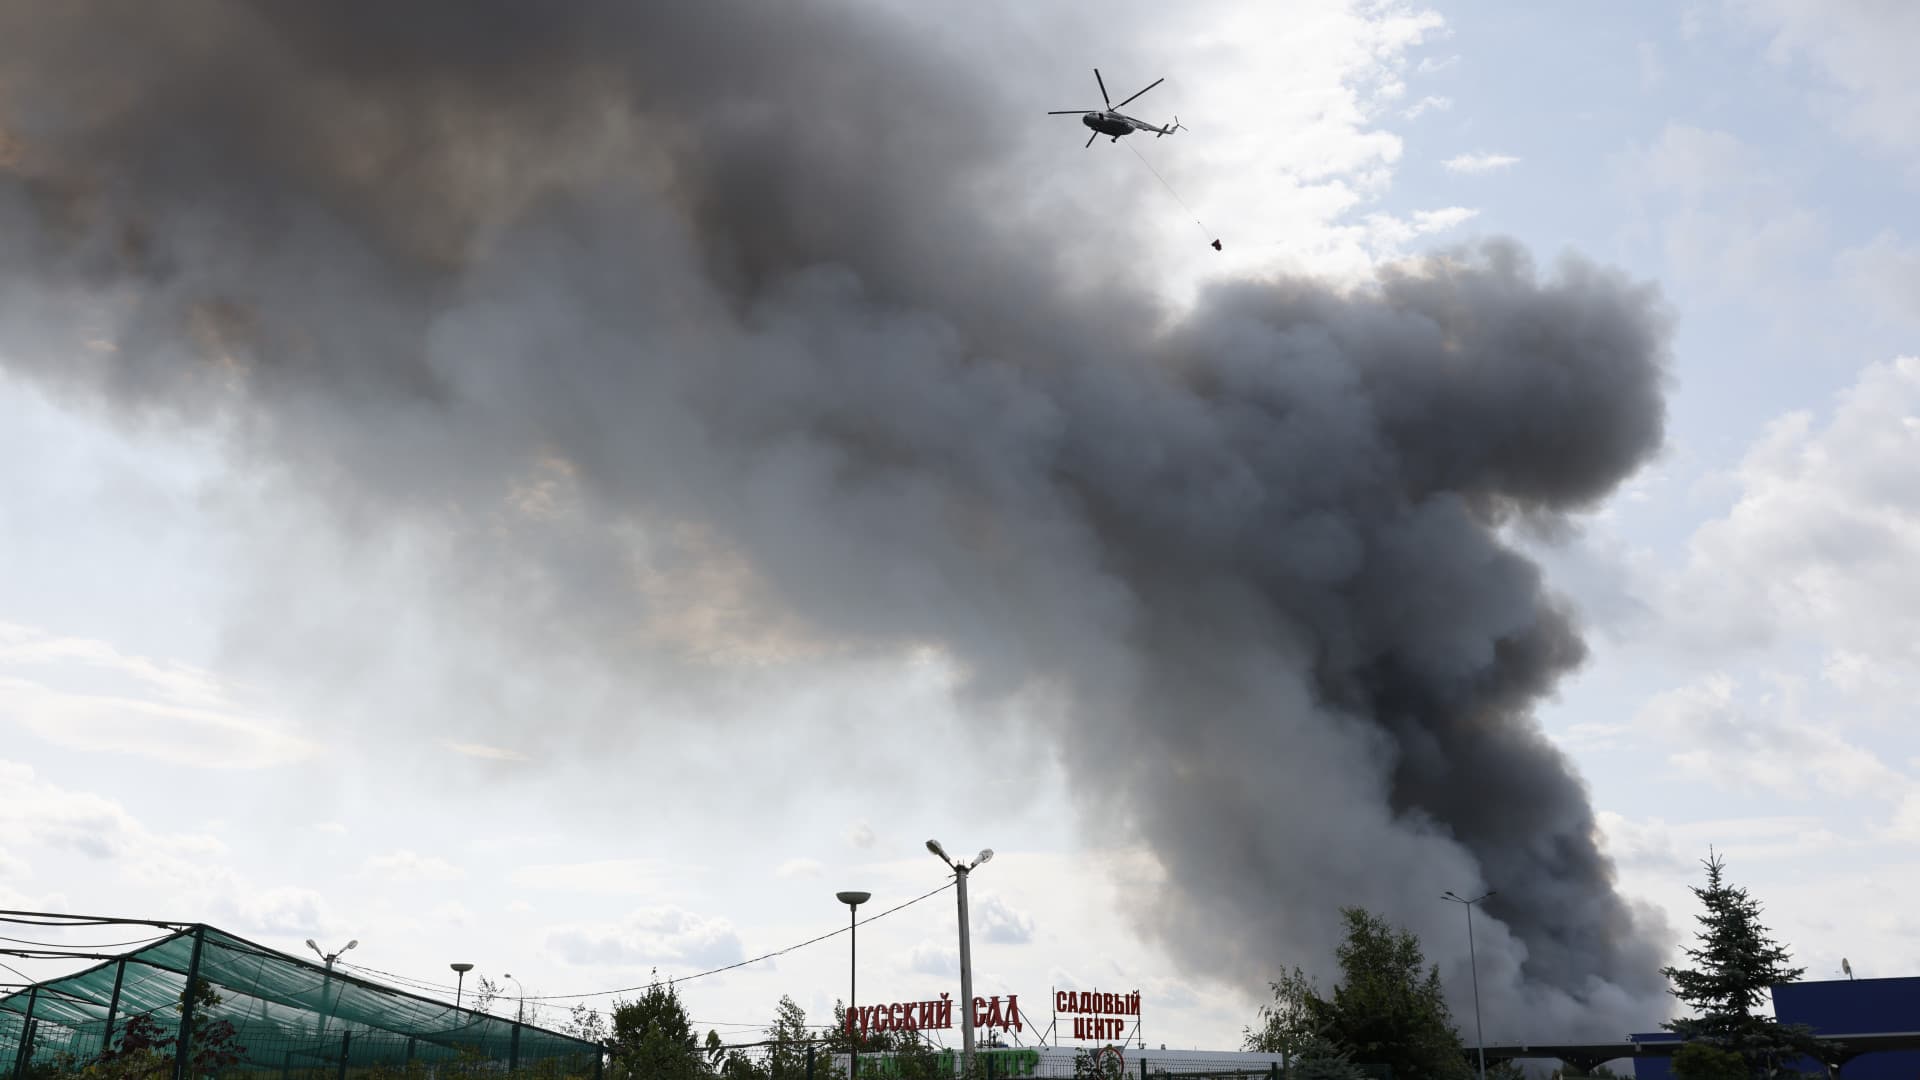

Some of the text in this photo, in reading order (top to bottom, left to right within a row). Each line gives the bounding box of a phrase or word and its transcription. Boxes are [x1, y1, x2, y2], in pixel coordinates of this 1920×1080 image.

[1056, 990, 1140, 1015] САДОВЫЙ
[845, 992, 1022, 1043] РУССКИЙ САД
[1073, 1017, 1124, 1040] ЦЕНТР
